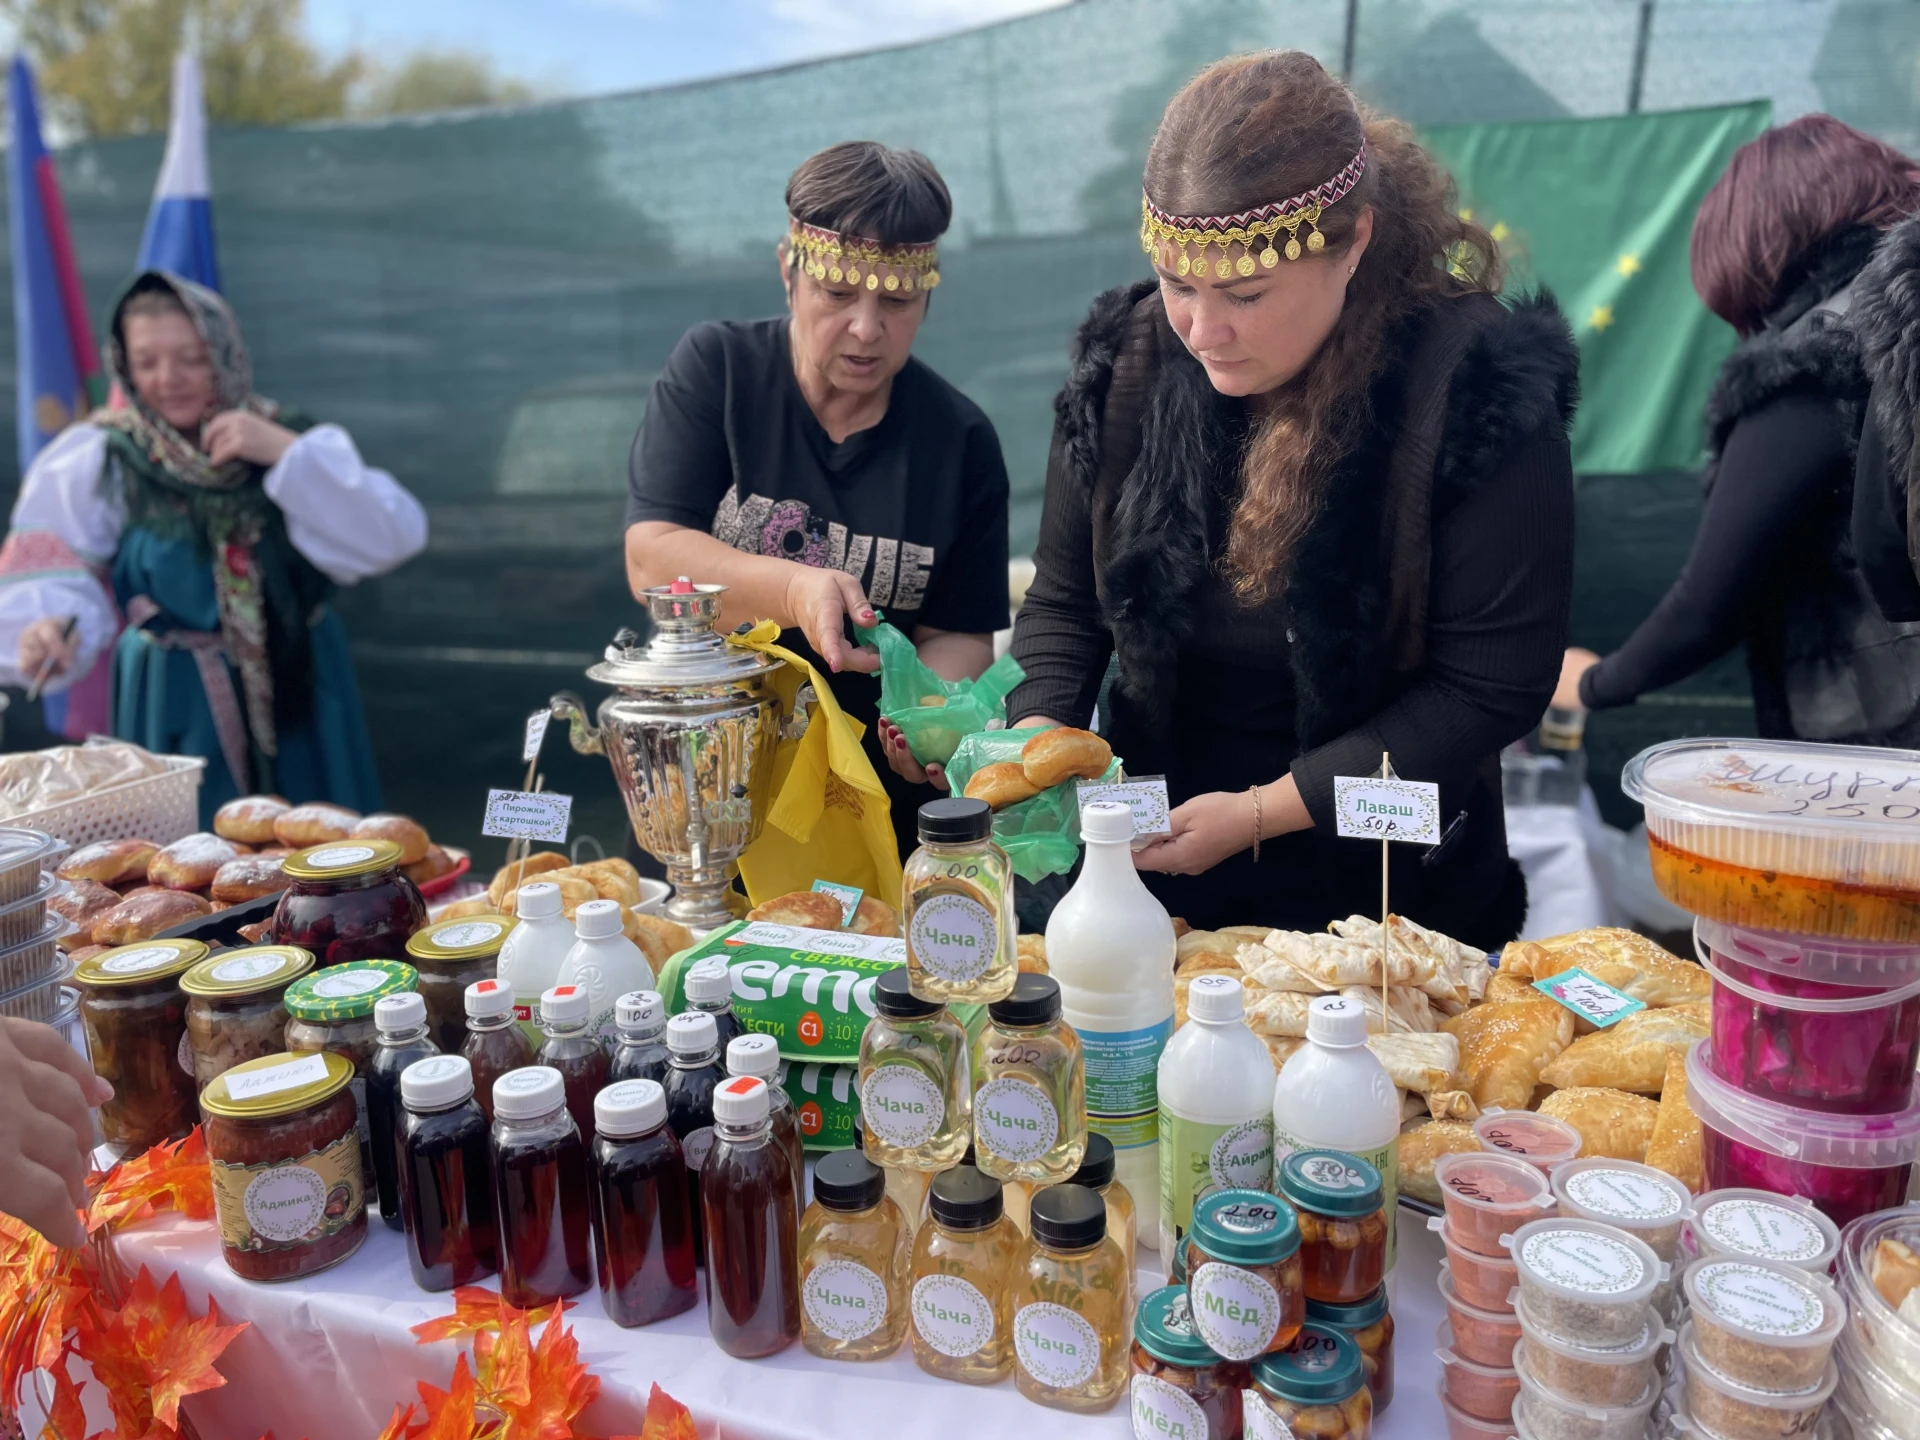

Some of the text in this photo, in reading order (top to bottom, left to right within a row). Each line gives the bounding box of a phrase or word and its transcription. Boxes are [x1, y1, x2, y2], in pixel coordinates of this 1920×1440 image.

[502, 802, 546, 814] Пирожки
[1356, 798, 1413, 817] Лаваш
[1767, 799, 1920, 819] 250
[499, 815, 551, 827] картошкой
[751, 927, 787, 940] Яйца
[924, 927, 976, 947] Чача
[818, 937, 858, 950] Яйца
[789, 950, 906, 972] СВЕЖЕСТ
[834, 1024, 851, 1040] 10
[875, 1095, 924, 1114] Чача
[834, 1114, 851, 1130] 10
[987, 1110, 1038, 1130] Чача
[1621, 1182, 1641, 1198] Соль
[258, 1193, 313, 1212] Аджика
[1224, 1205, 1278, 1220] 200
[1768, 1219, 1780, 1237] Соль
[1575, 1246, 1602, 1263] Соль
[817, 1287, 866, 1310] Чача
[1744, 1284, 1778, 1300] Соль
[923, 1301, 972, 1325] Чача
[1204, 1292, 1259, 1327] Мёд
[1026, 1329, 1077, 1356] Чача
[1138, 1399, 1185, 1440] Мёд
